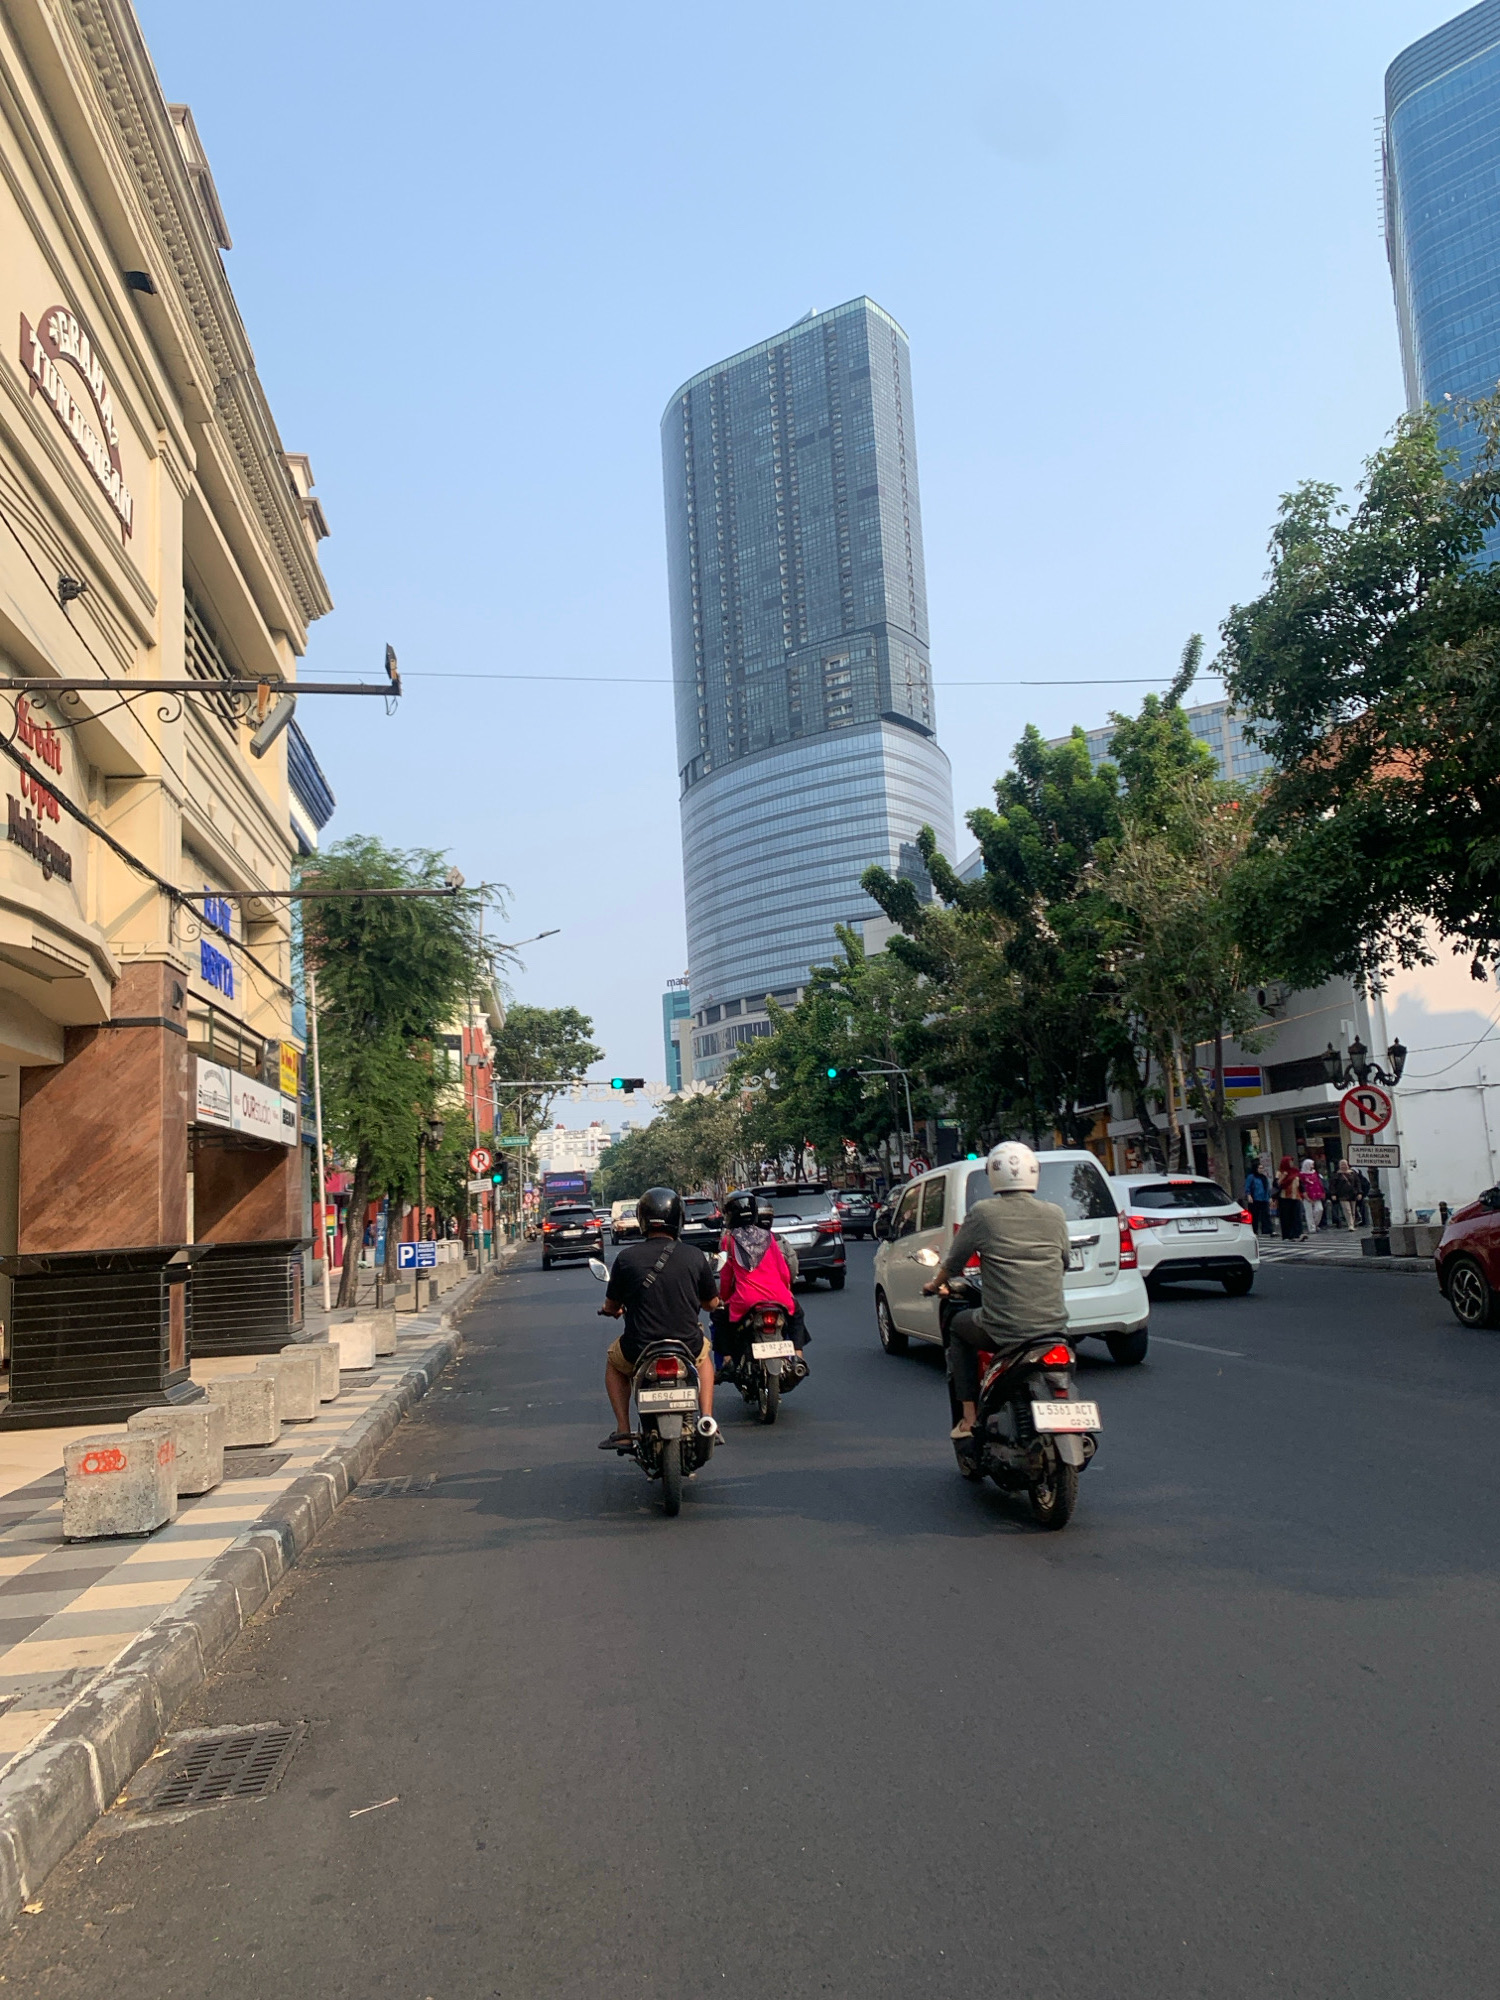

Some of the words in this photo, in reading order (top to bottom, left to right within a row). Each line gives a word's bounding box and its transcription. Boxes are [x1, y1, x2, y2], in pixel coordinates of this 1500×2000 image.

[29, 329, 132, 528] TUNJUNGAN
[18, 694, 63, 776] Kredit
[400, 1246, 414, 1266] P
[1037, 1405, 1044, 1415] L
[1046, 1404, 1071, 1415] 5361
[1075, 1404, 1092, 1415] ACT
